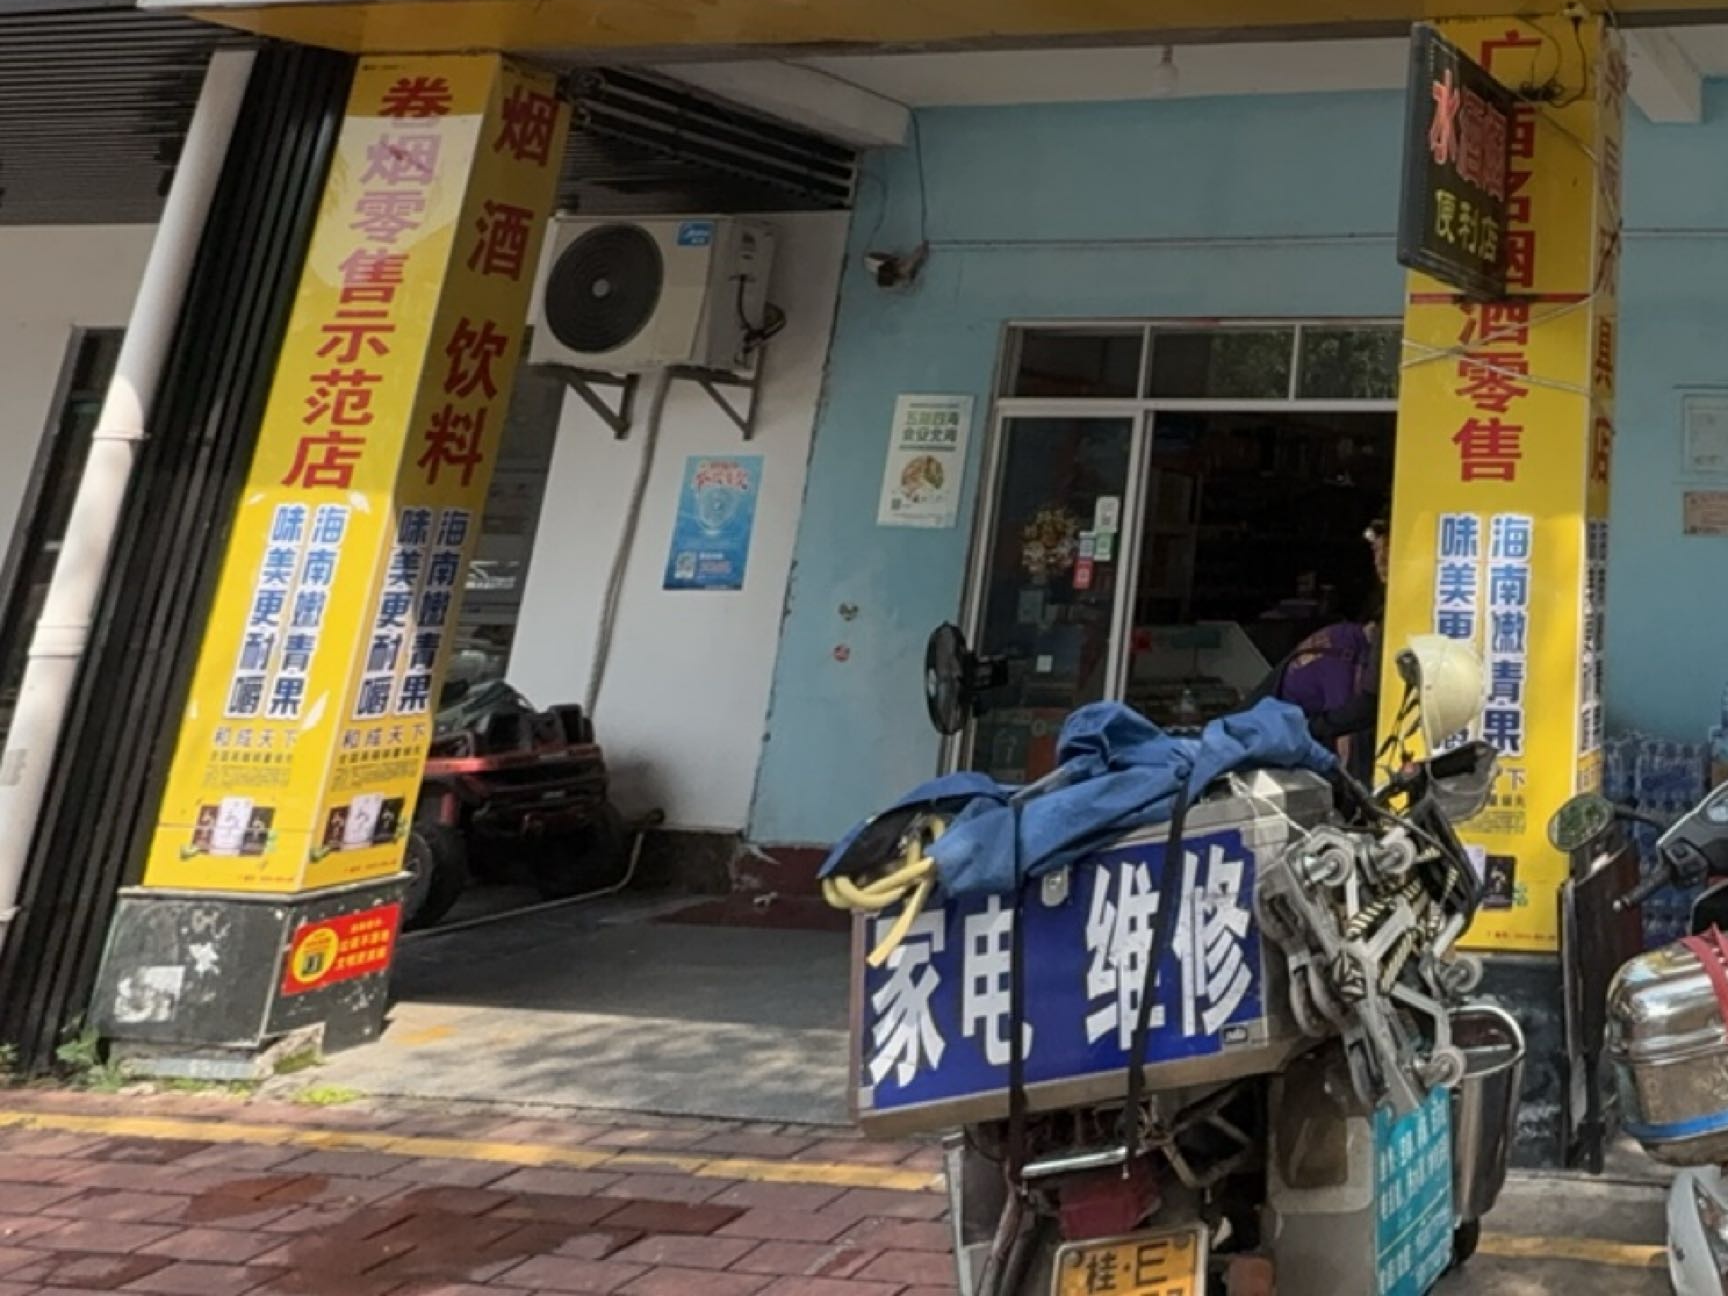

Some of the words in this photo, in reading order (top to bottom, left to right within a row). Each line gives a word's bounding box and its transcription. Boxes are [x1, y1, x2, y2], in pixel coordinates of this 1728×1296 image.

[281, 76, 454, 491] 卷烟零售示范店
[418, 86, 561, 488] 烟酒饮料
[226, 503, 305, 719] 味美更耐嚼
[268, 504, 349, 719] 海南嫩青果
[397, 508, 472, 714] 海南嫩青果
[1484, 515, 1532, 754] 海南嫩青果
